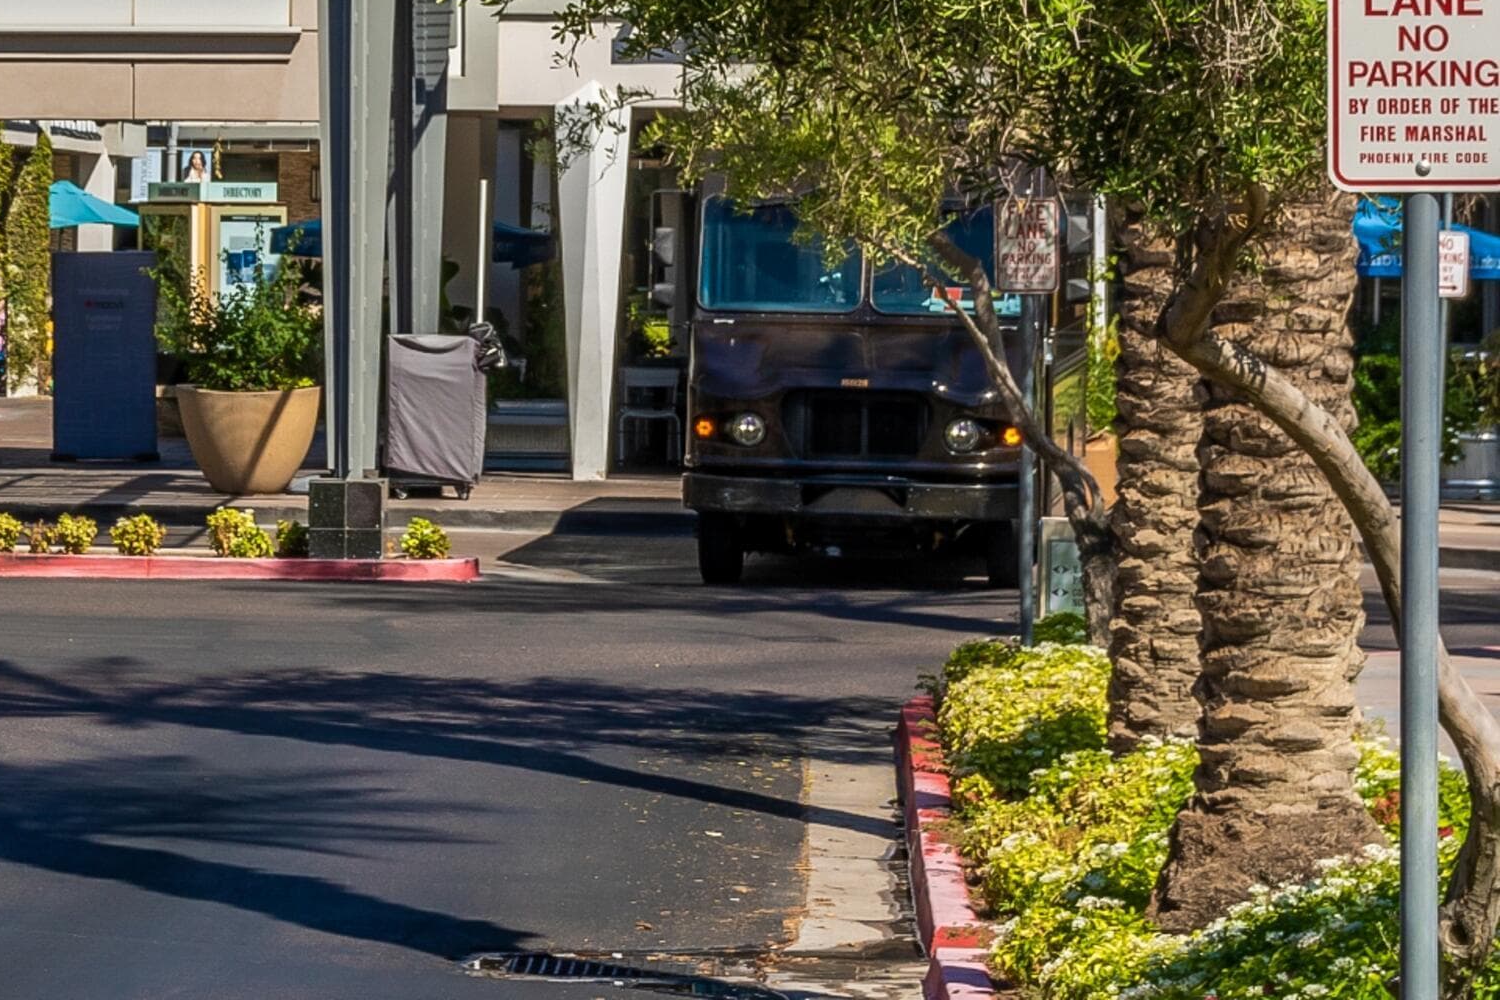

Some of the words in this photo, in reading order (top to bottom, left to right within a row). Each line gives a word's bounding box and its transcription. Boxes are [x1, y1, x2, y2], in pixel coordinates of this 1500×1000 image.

[1398, 24, 1449, 51] NO
[1348, 60, 1499, 87] PARKING
[1348, 98, 1369, 115] BY
[1377, 98, 1432, 115] ORDER
[1440, 98, 1460, 115] OF
[1468, 98, 1499, 115] THE
[1360, 125, 1396, 142] FIRE
[1405, 125, 1487, 142] MARSHAL
[1359, 152, 1414, 164] PHOENIX
[1420, 152, 1449, 164] FIRE
[1455, 152, 1489, 164] CODE
[1017, 240, 1037, 252] NO
[1001, 253, 1052, 265] PARKING
